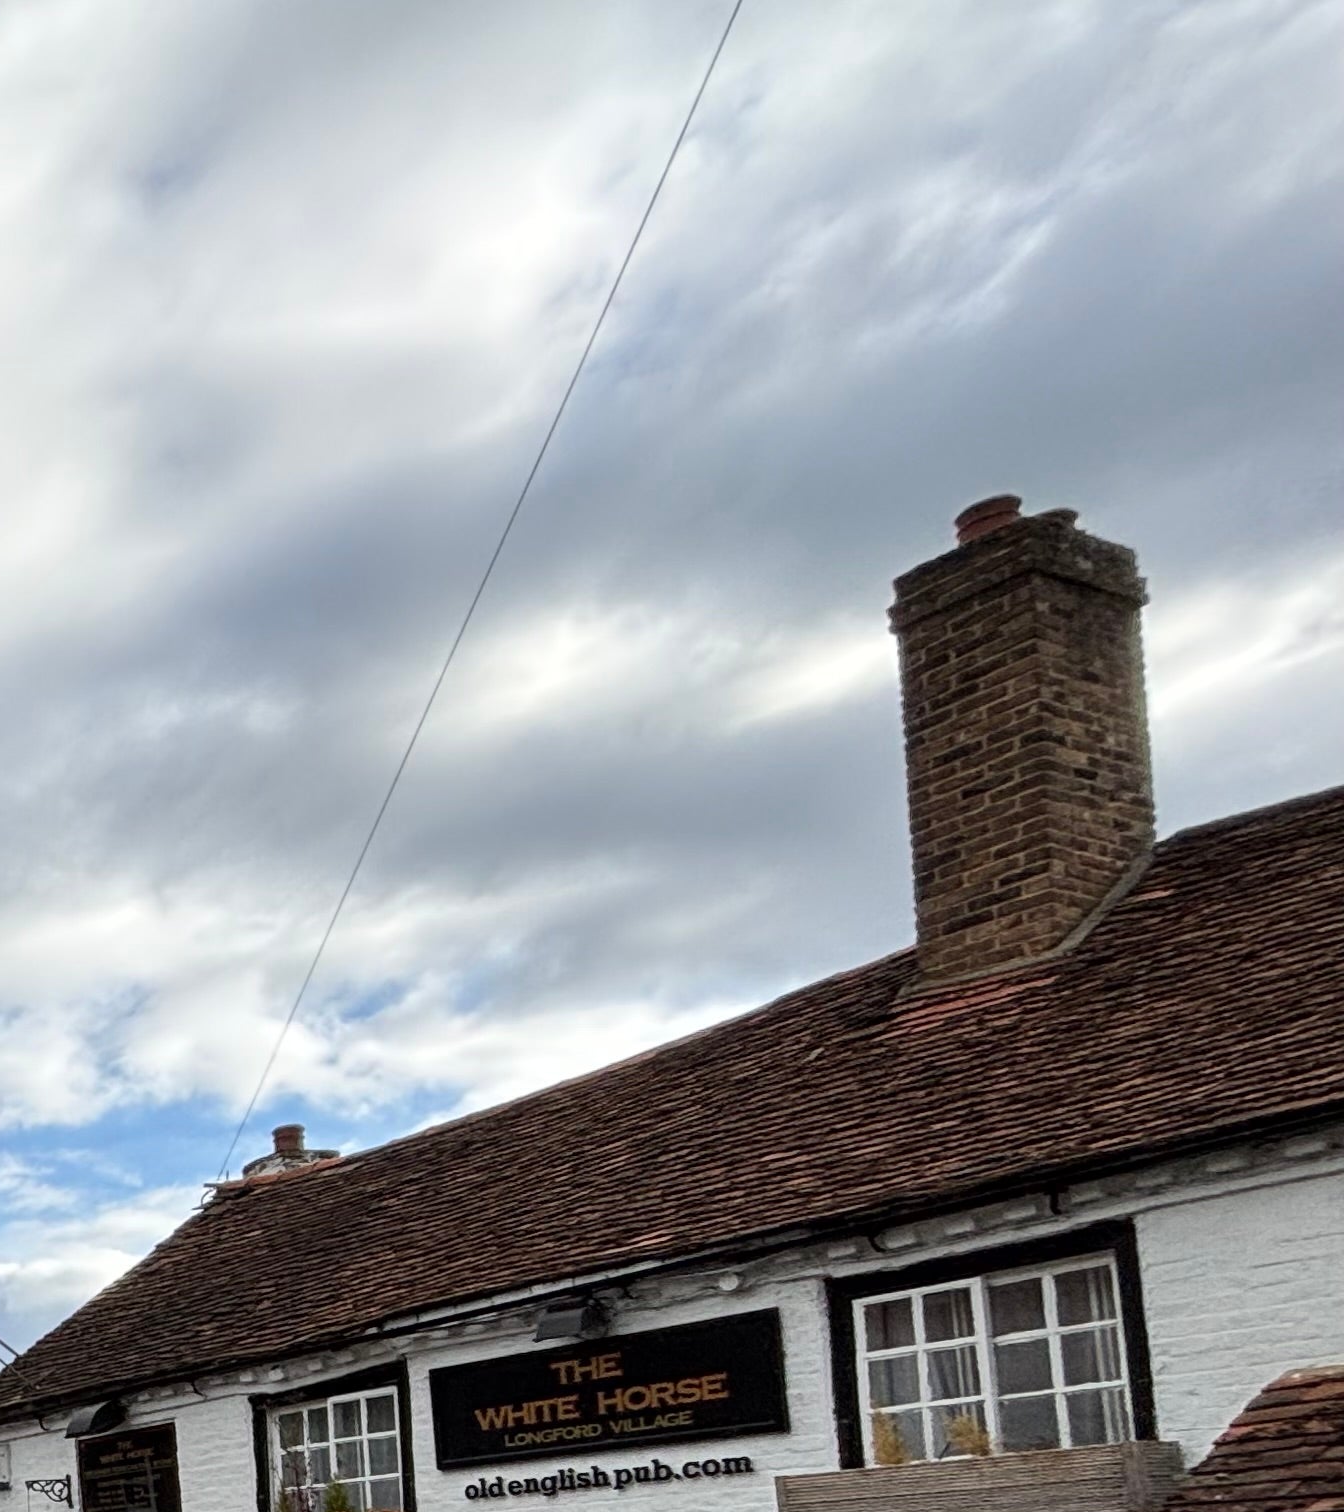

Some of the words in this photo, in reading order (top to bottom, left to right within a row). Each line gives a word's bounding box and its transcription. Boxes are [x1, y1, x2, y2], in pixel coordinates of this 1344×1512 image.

[549, 1351, 623, 1385] THE
[474, 1393, 581, 1432] WHITE
[597, 1371, 731, 1416] HORSE
[505, 1422, 603, 1448] LONGFORD
[609, 1410, 695, 1435] VILLAGE
[464, 1454, 754, 1501] oldenglishpub.com
